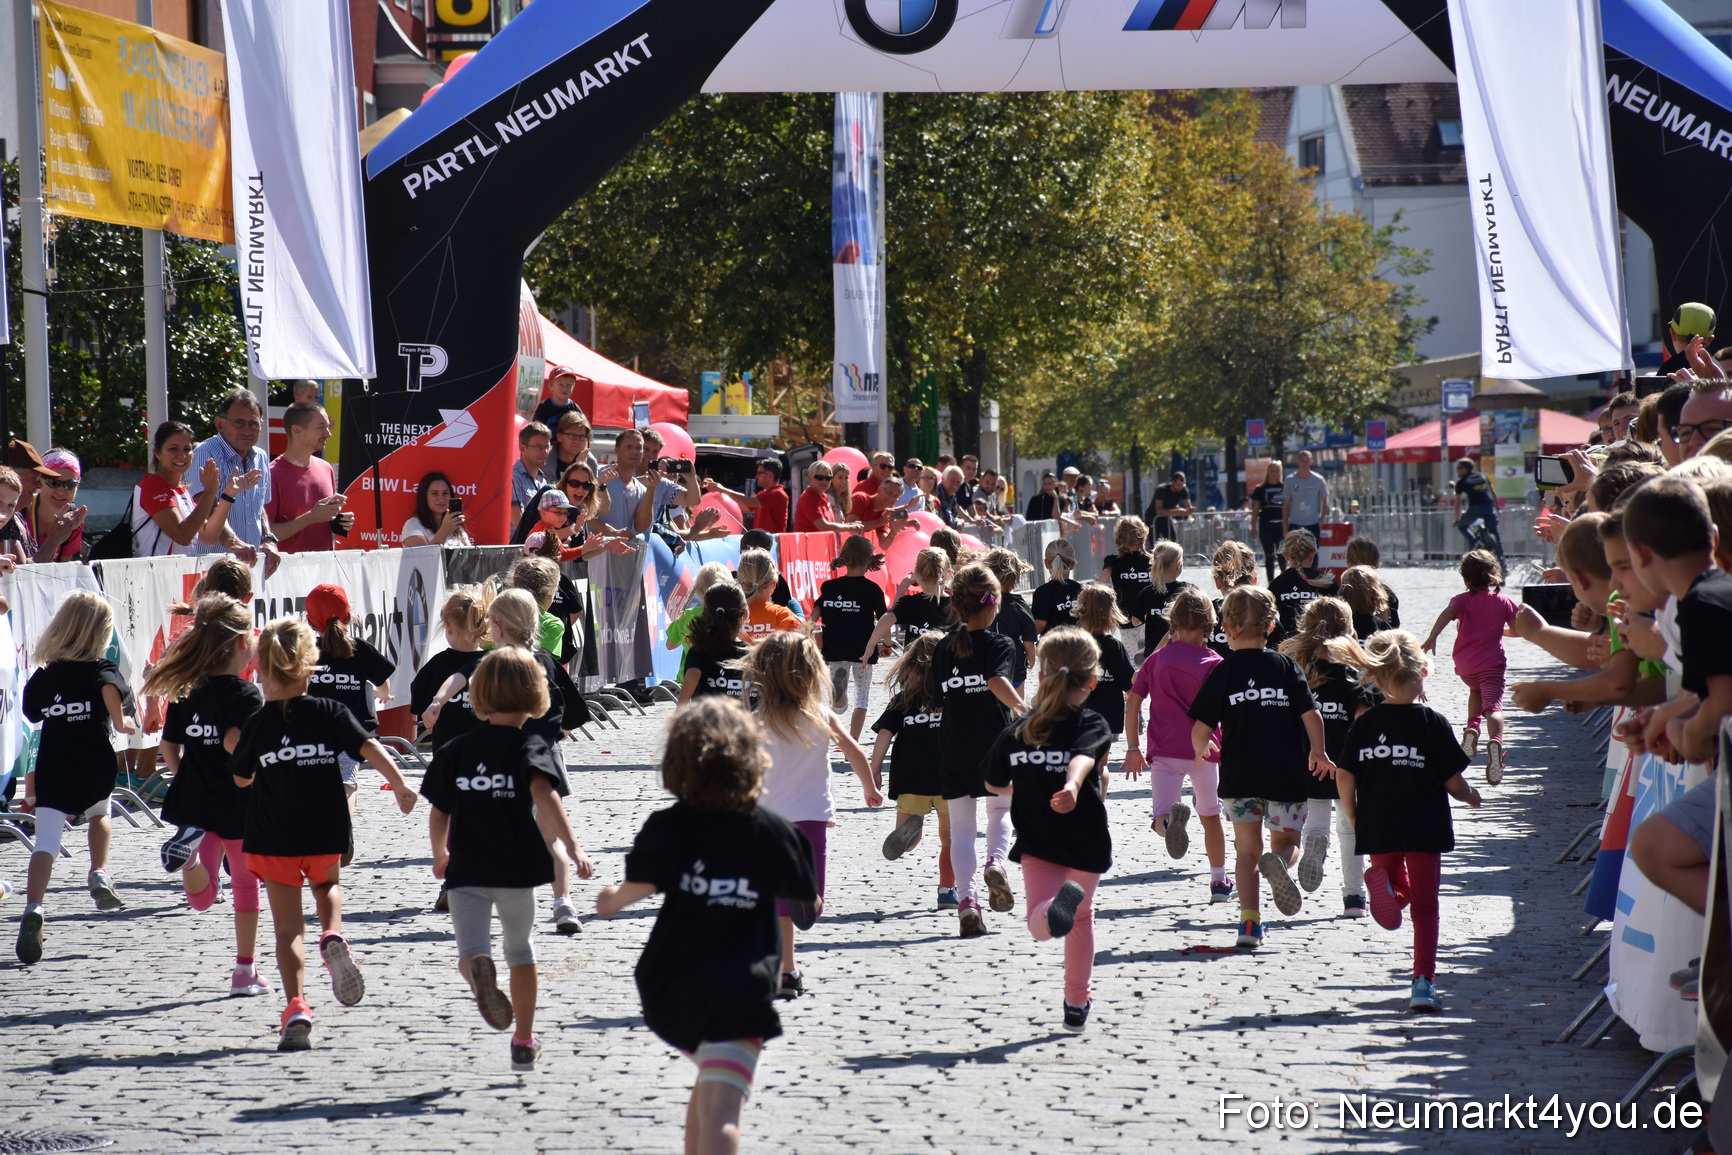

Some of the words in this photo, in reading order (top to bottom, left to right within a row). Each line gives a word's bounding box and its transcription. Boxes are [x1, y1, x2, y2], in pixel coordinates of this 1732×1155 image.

[402, 134, 498, 200] PARTL
[495, 32, 655, 146] NEUMARKT
[1605, 73, 1732, 163] NEUMAR
[380, 422, 401, 434] THE
[403, 423, 433, 436] NEXT
[381, 434, 418, 447] YEARS
[1260, 698, 1290, 708] energie
[296, 756, 336, 767] energie
[1391, 757, 1426, 769] energie
